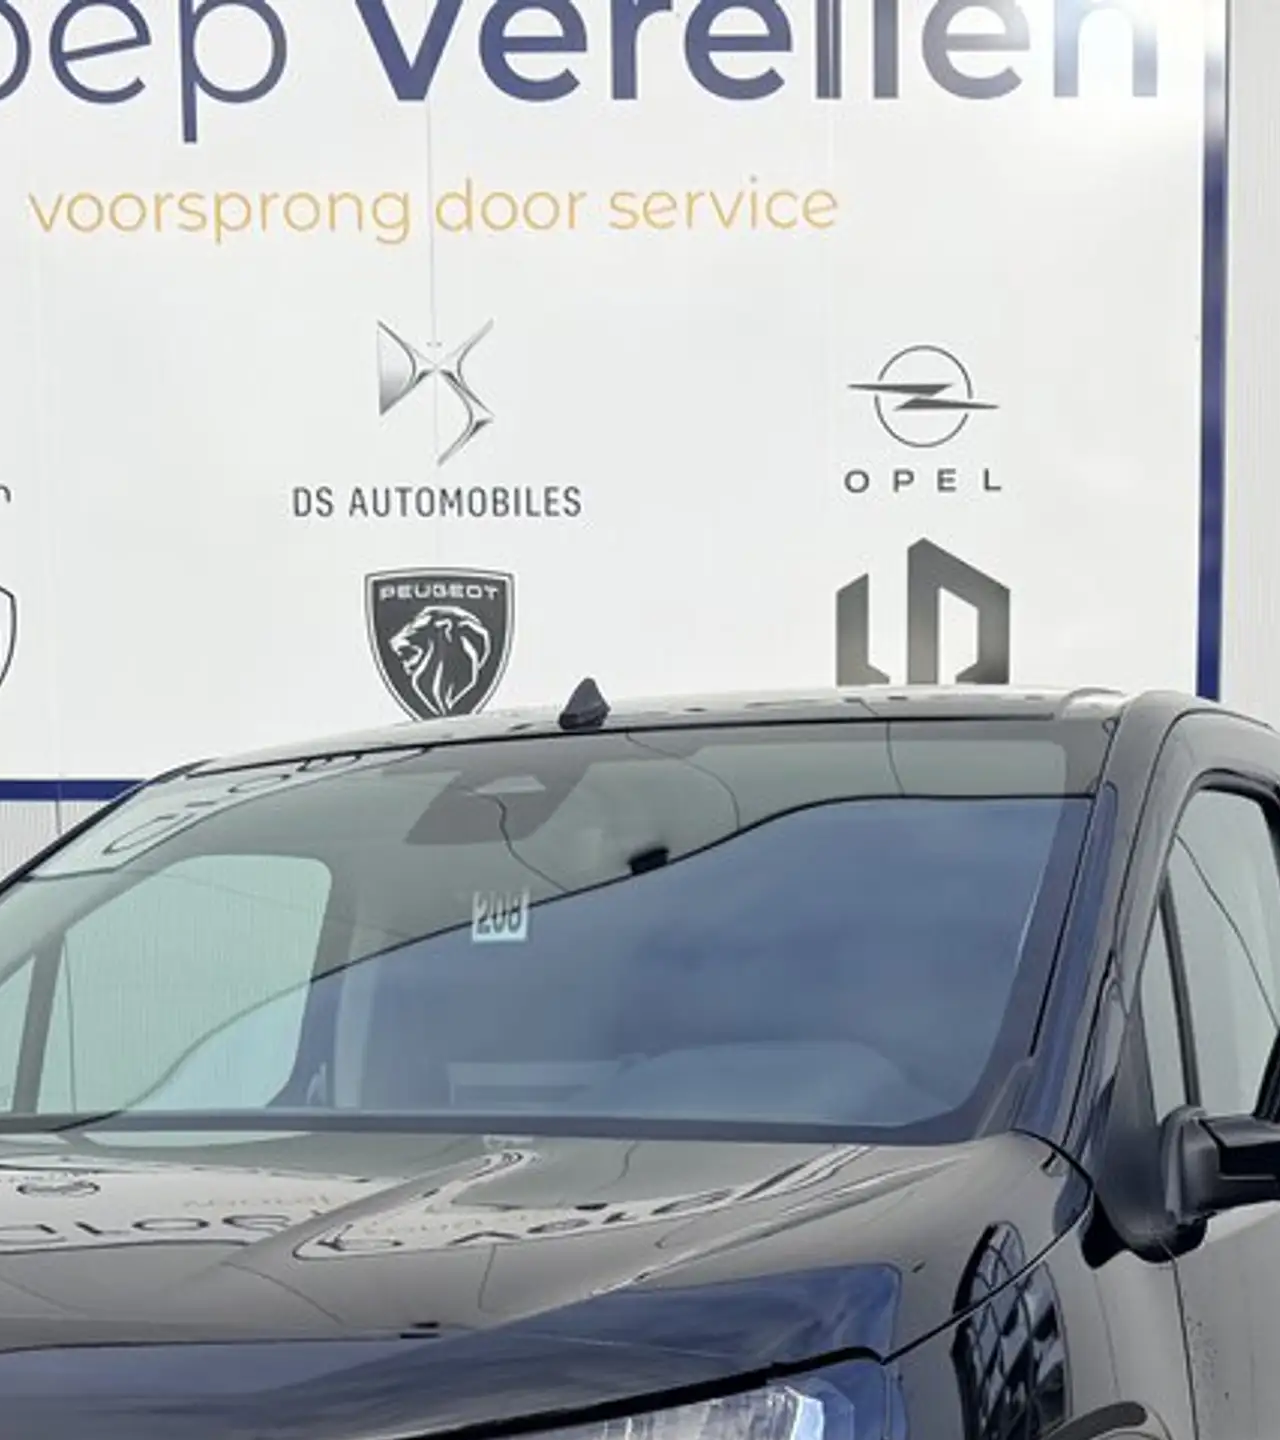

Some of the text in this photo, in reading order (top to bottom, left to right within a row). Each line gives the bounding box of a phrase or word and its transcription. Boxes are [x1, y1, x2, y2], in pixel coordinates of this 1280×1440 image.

[28, 176, 838, 244] voorsprong door service
[843, 467, 1003, 494] OPEL
[292, 485, 582, 519] DS AUTOMOBILES
[379, 583, 500, 602] PEUGEOT
